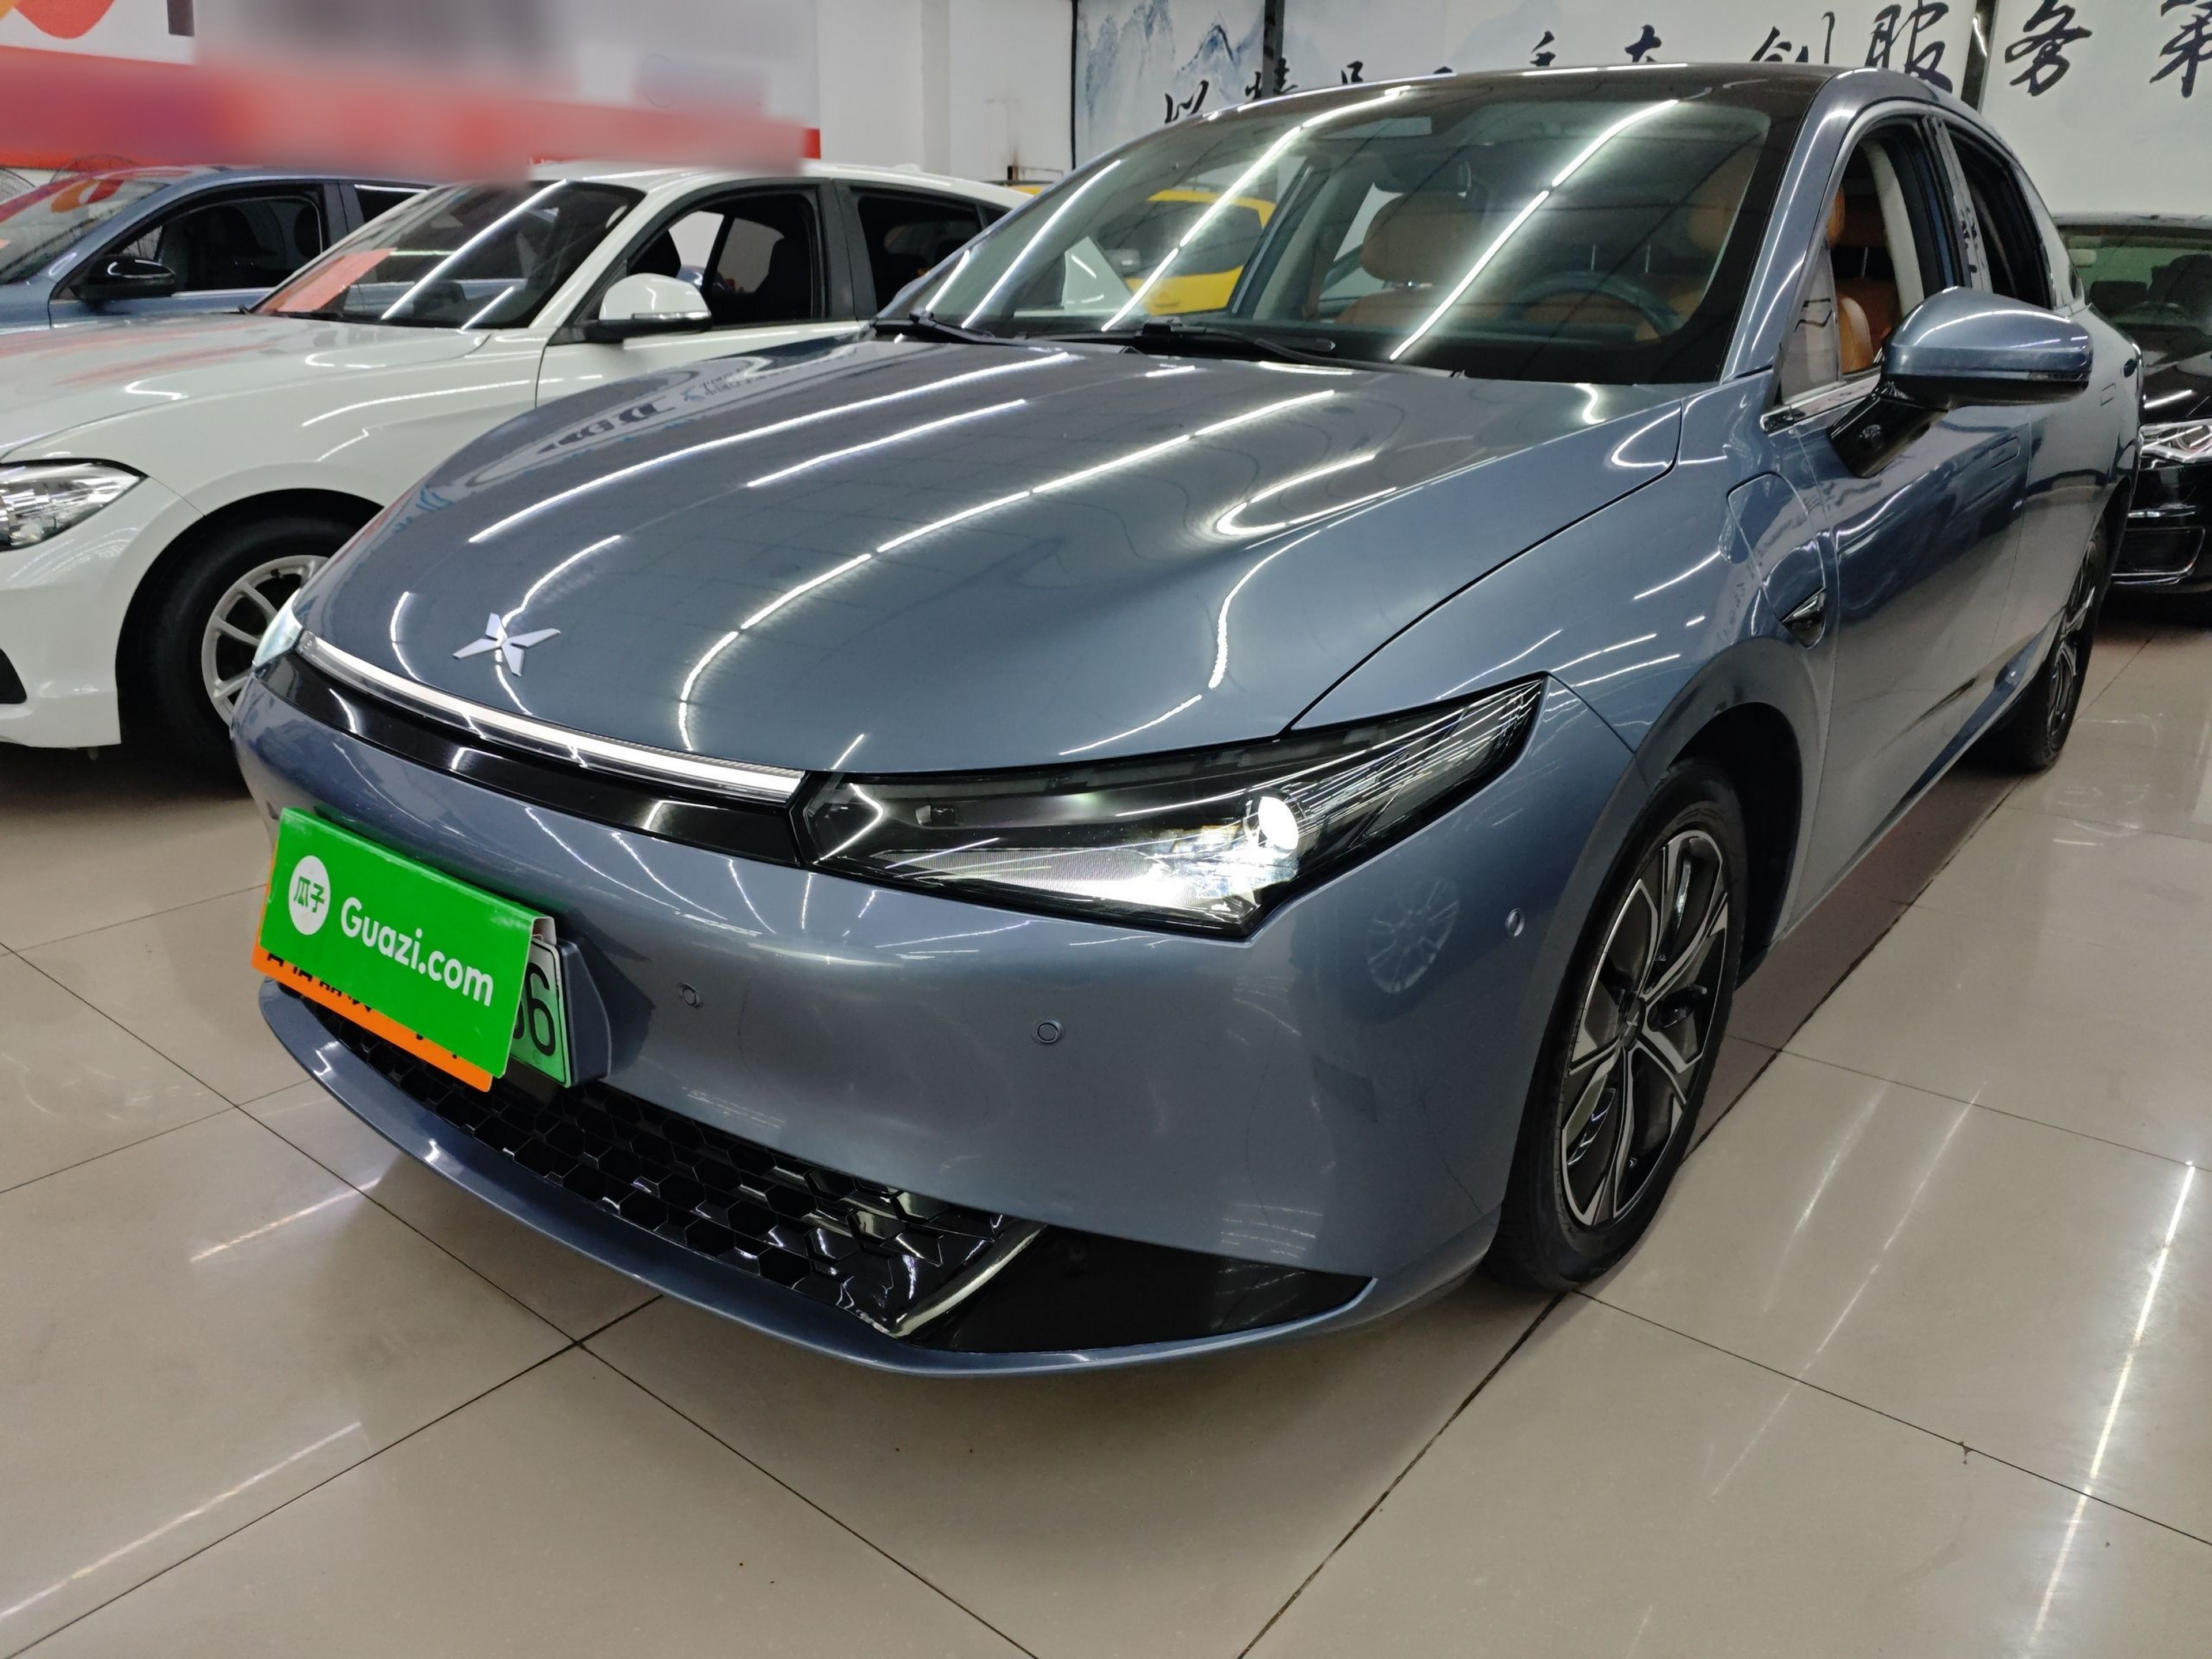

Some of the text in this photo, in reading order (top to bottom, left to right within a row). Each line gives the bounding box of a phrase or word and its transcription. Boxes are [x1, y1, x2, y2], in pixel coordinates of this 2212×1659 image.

[293, 876, 325, 913] 瓜子
[341, 896, 494, 1007] Guazi.com
[513, 961, 556, 1057] 6
